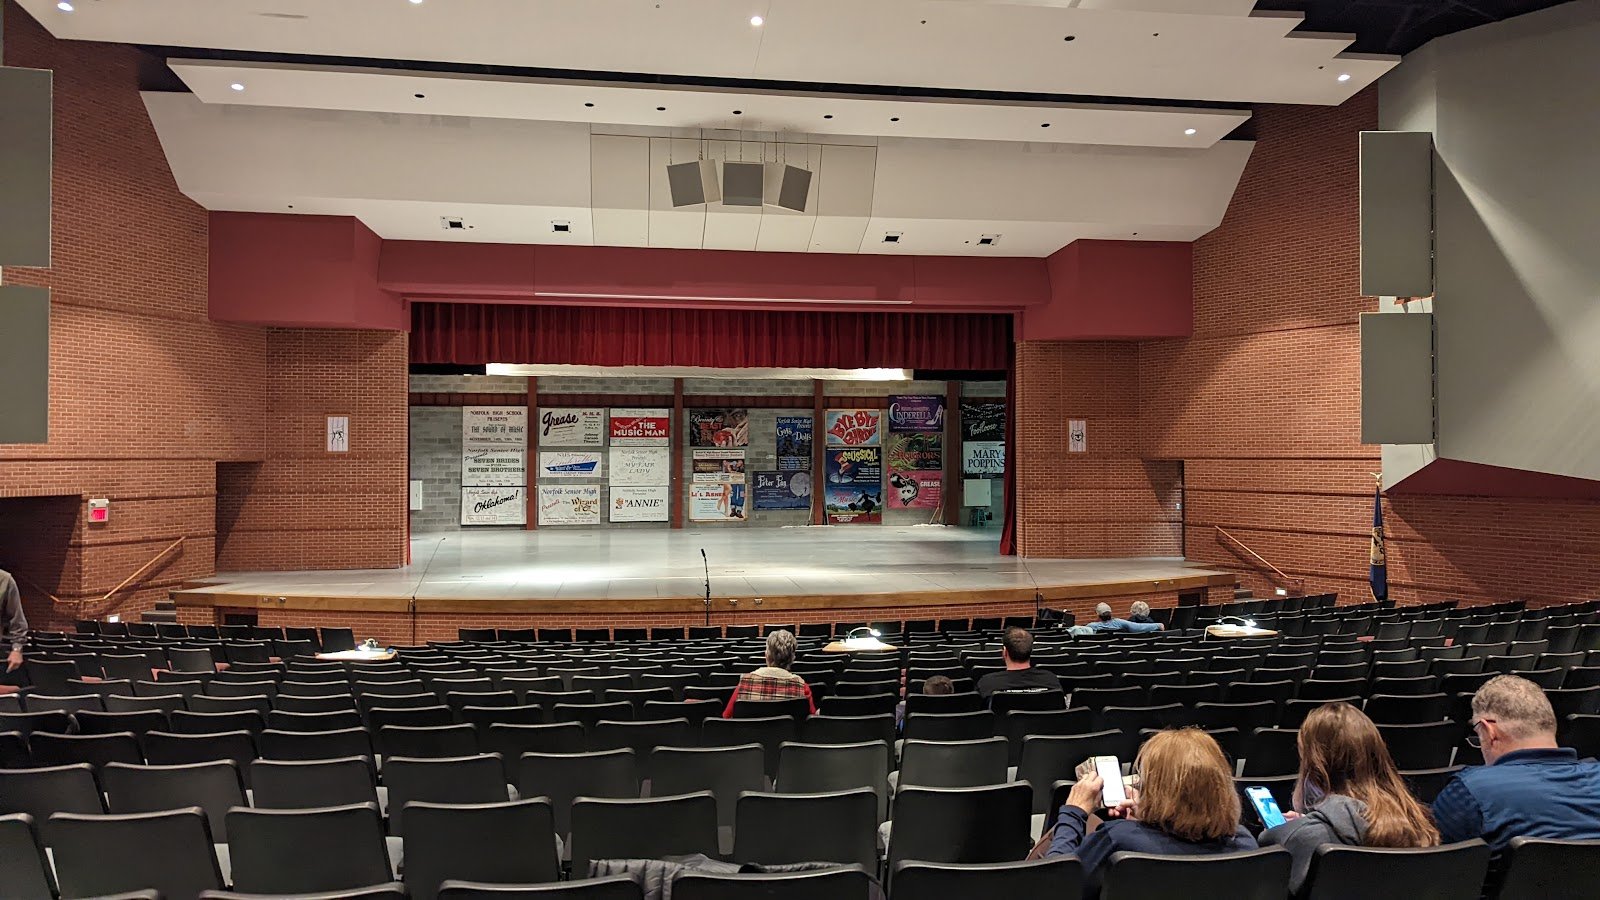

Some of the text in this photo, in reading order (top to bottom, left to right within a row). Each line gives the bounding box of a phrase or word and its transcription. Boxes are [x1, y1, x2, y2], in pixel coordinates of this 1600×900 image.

[889, 402, 932, 424] CINDERELLA
[638, 422, 656, 430] THE
[827, 414, 856, 440] BYE
[854, 410, 879, 427] BYE
[970, 420, 998, 436] Footloose
[614, 426, 644, 436] MUSIC
[776, 426, 792, 438] Guys
[843, 427, 876, 445] BIRDIE
[796, 432, 812, 441] Dolls
[973, 449, 1001, 458] MARY
[968, 459, 1005, 468] POPPINS
[758, 474, 774, 488] Peter
[582, 488, 596, 496] High
[474, 490, 518, 513] Oklahoma!
[571, 496, 598, 506] Wizard
[624, 499, 664, 508] "ANNIE"
